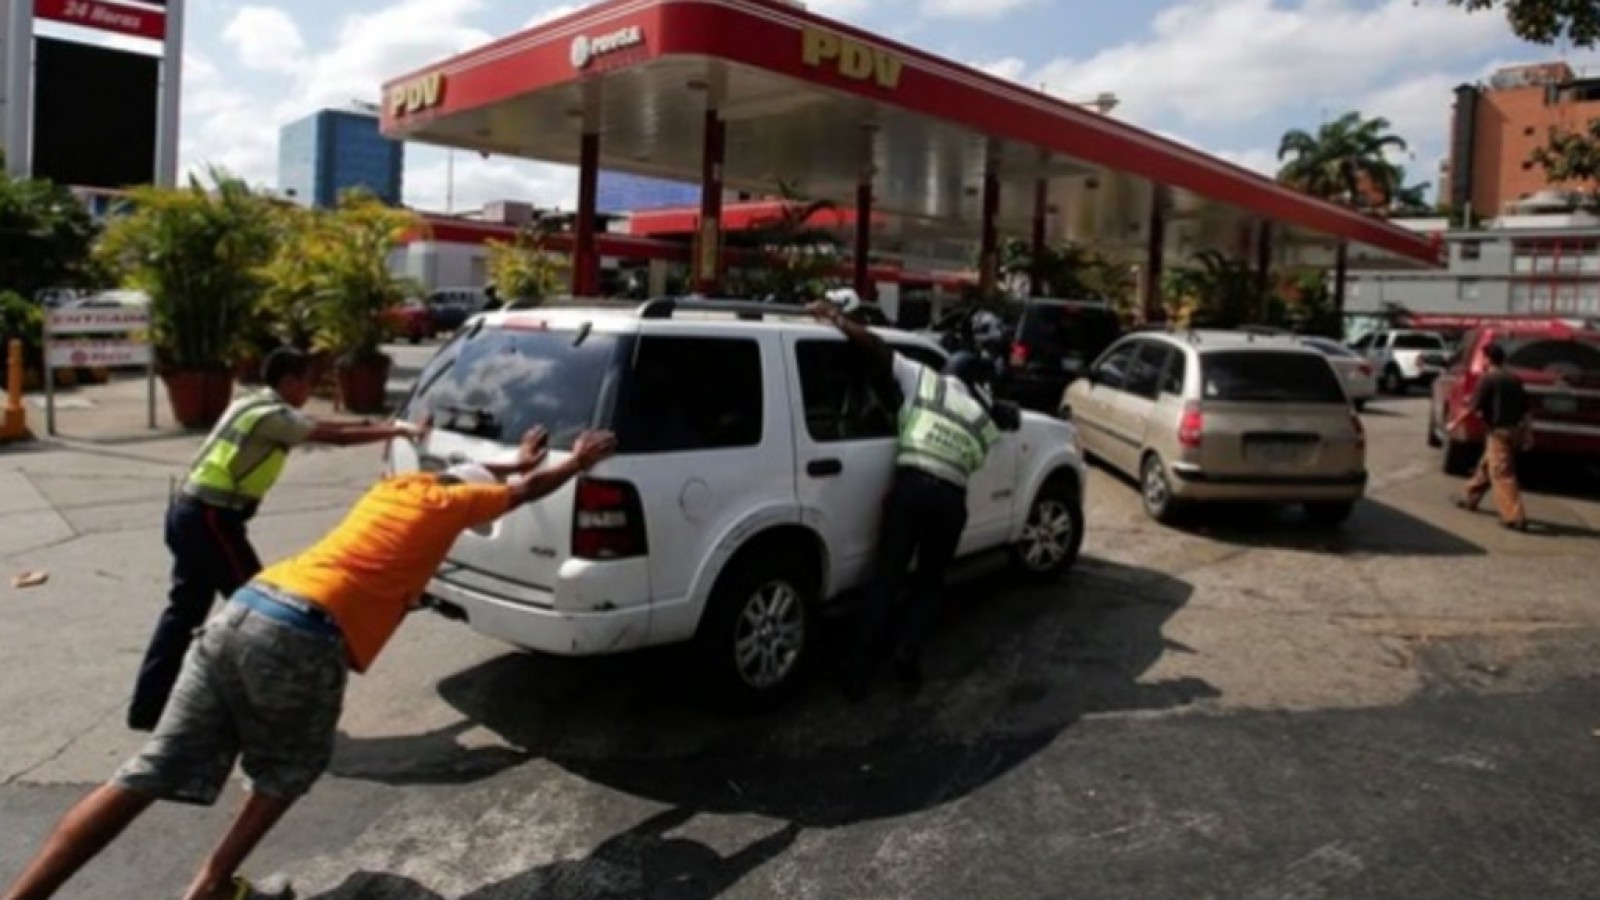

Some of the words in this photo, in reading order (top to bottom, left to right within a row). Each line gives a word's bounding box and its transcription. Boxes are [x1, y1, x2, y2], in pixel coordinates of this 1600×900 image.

[63, 0, 88, 17] 24
[802, 27, 902, 88] PDV
[390, 73, 441, 115] PDV
